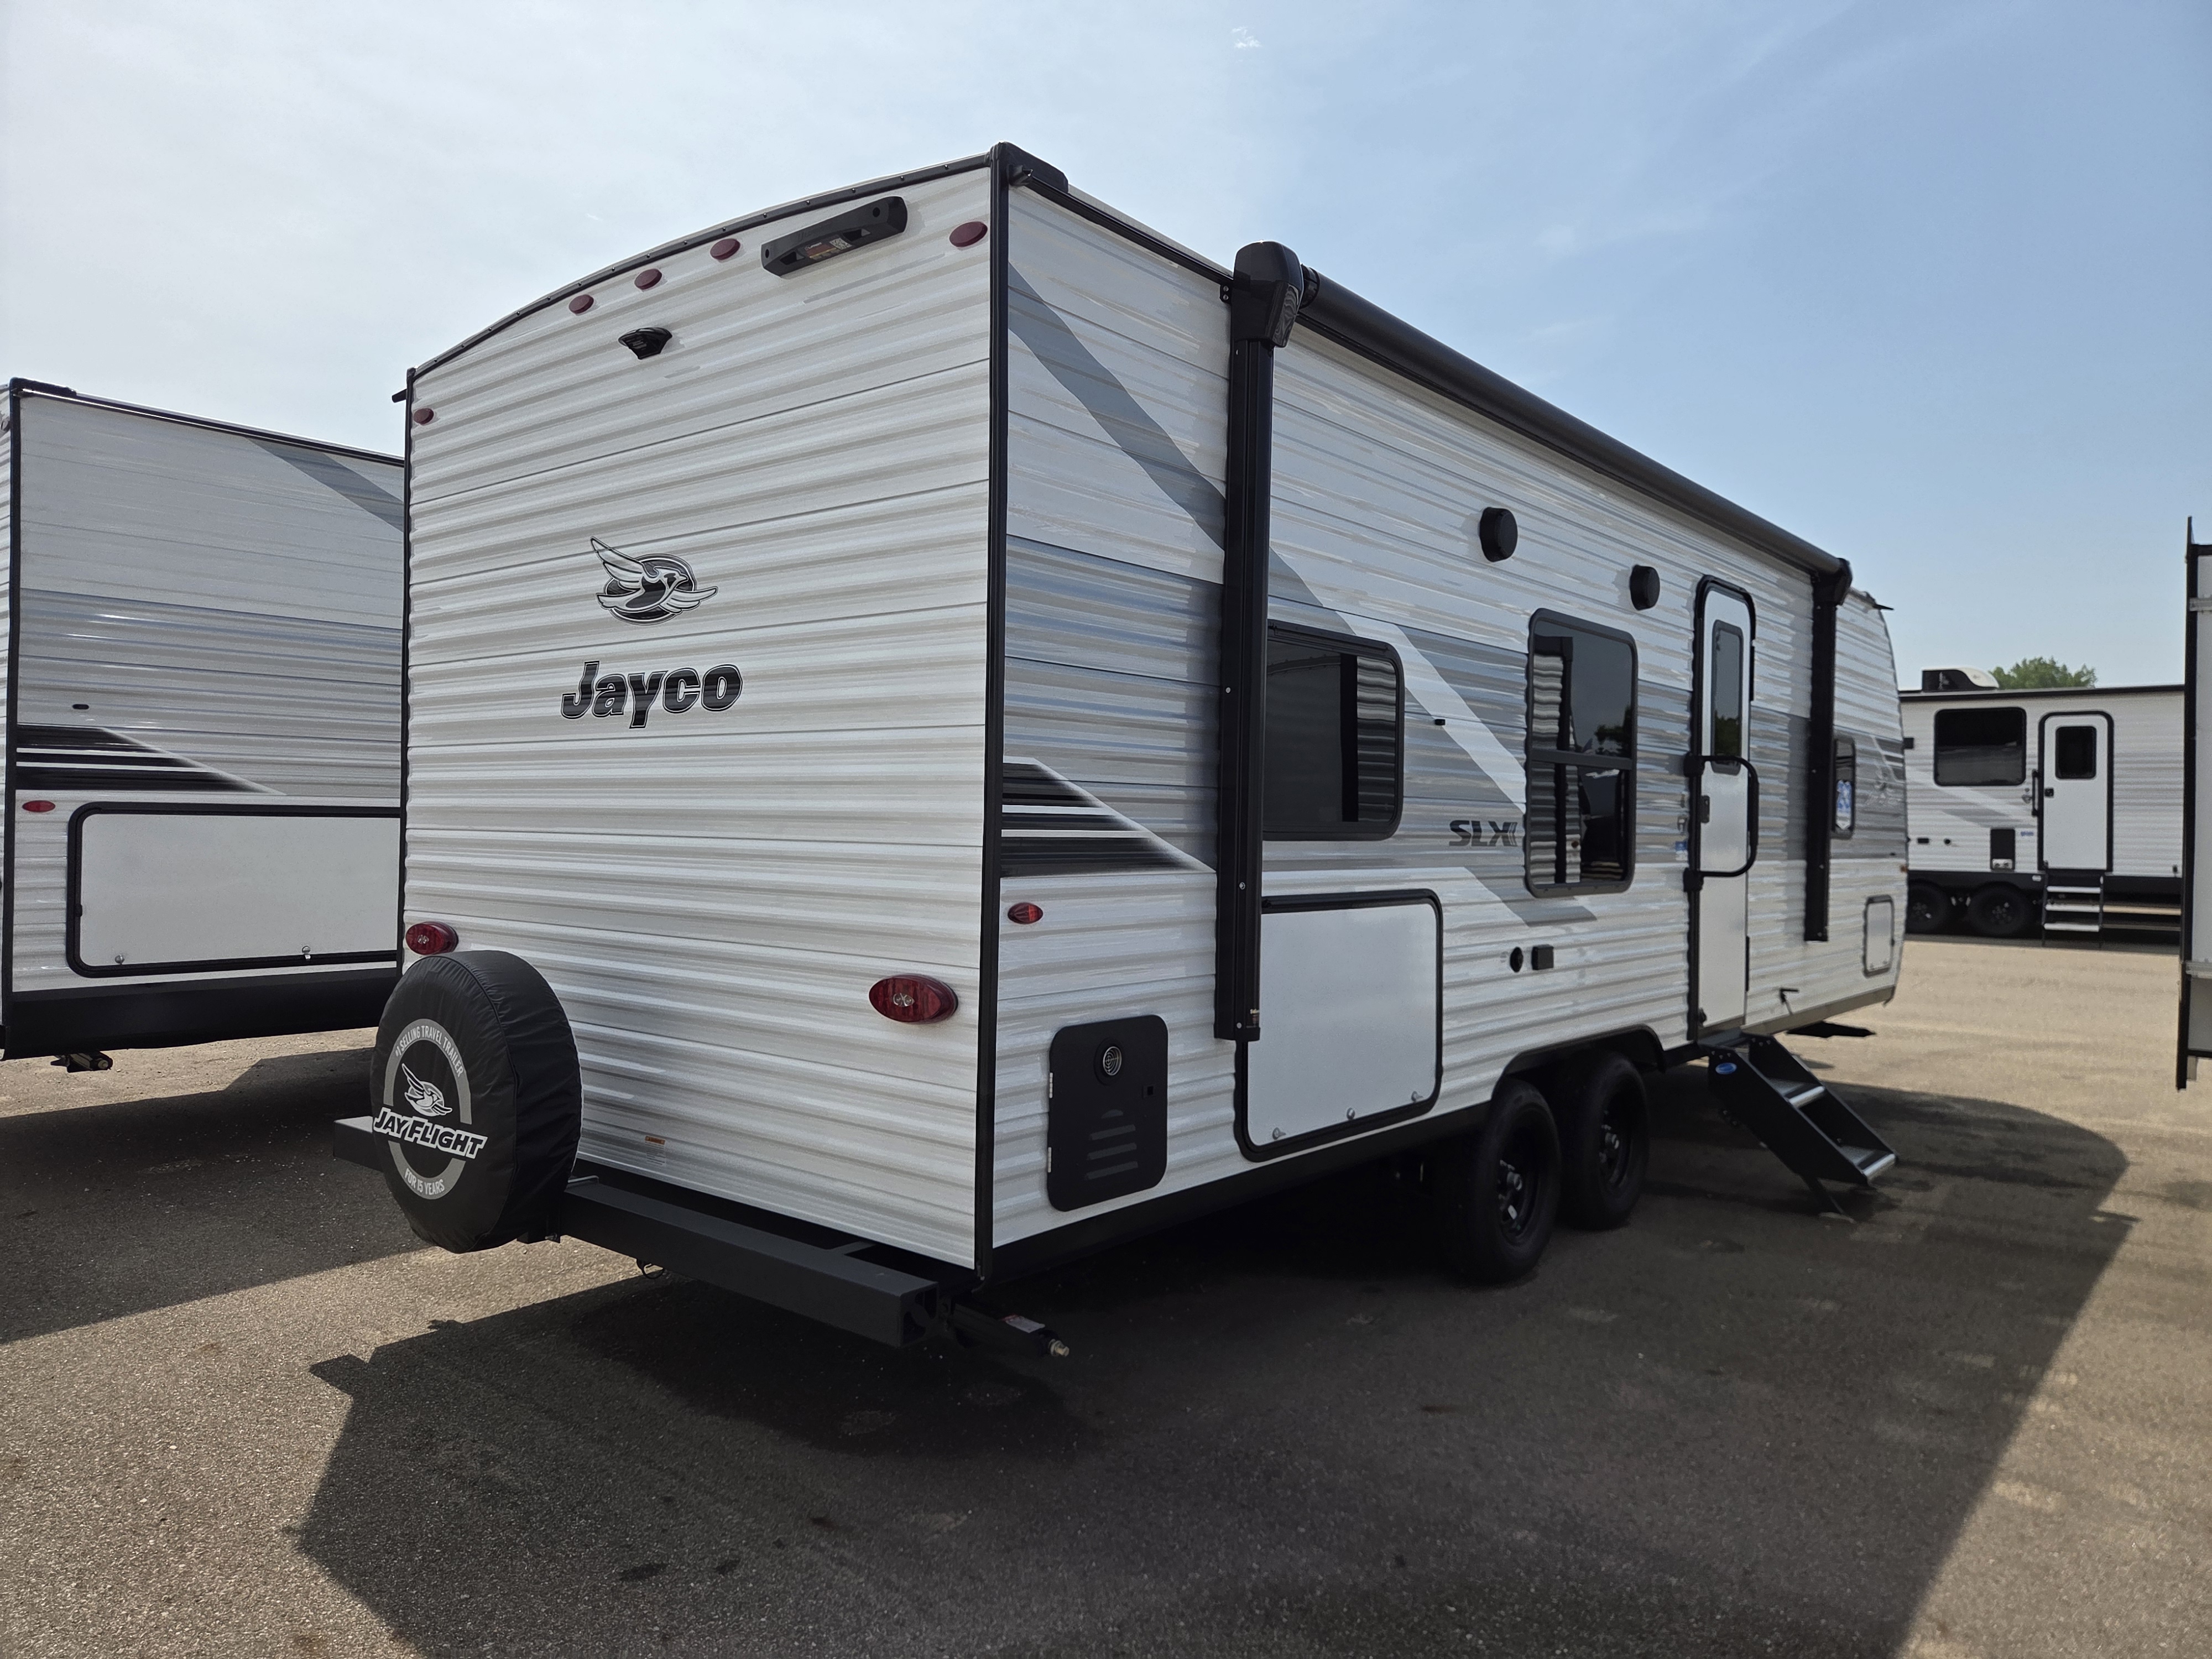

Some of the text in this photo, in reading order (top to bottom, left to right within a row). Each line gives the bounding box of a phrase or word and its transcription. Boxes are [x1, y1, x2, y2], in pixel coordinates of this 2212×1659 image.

[560, 660, 743, 729] Jayco
[1449, 820, 1518, 847] SLX
[400, 1026, 420, 1052] SELLING
[421, 1025, 442, 1045] TRAVEL
[442, 1036, 464, 1077] TRAILER
[404, 1167, 445, 1196] FOR 15 YEARS
